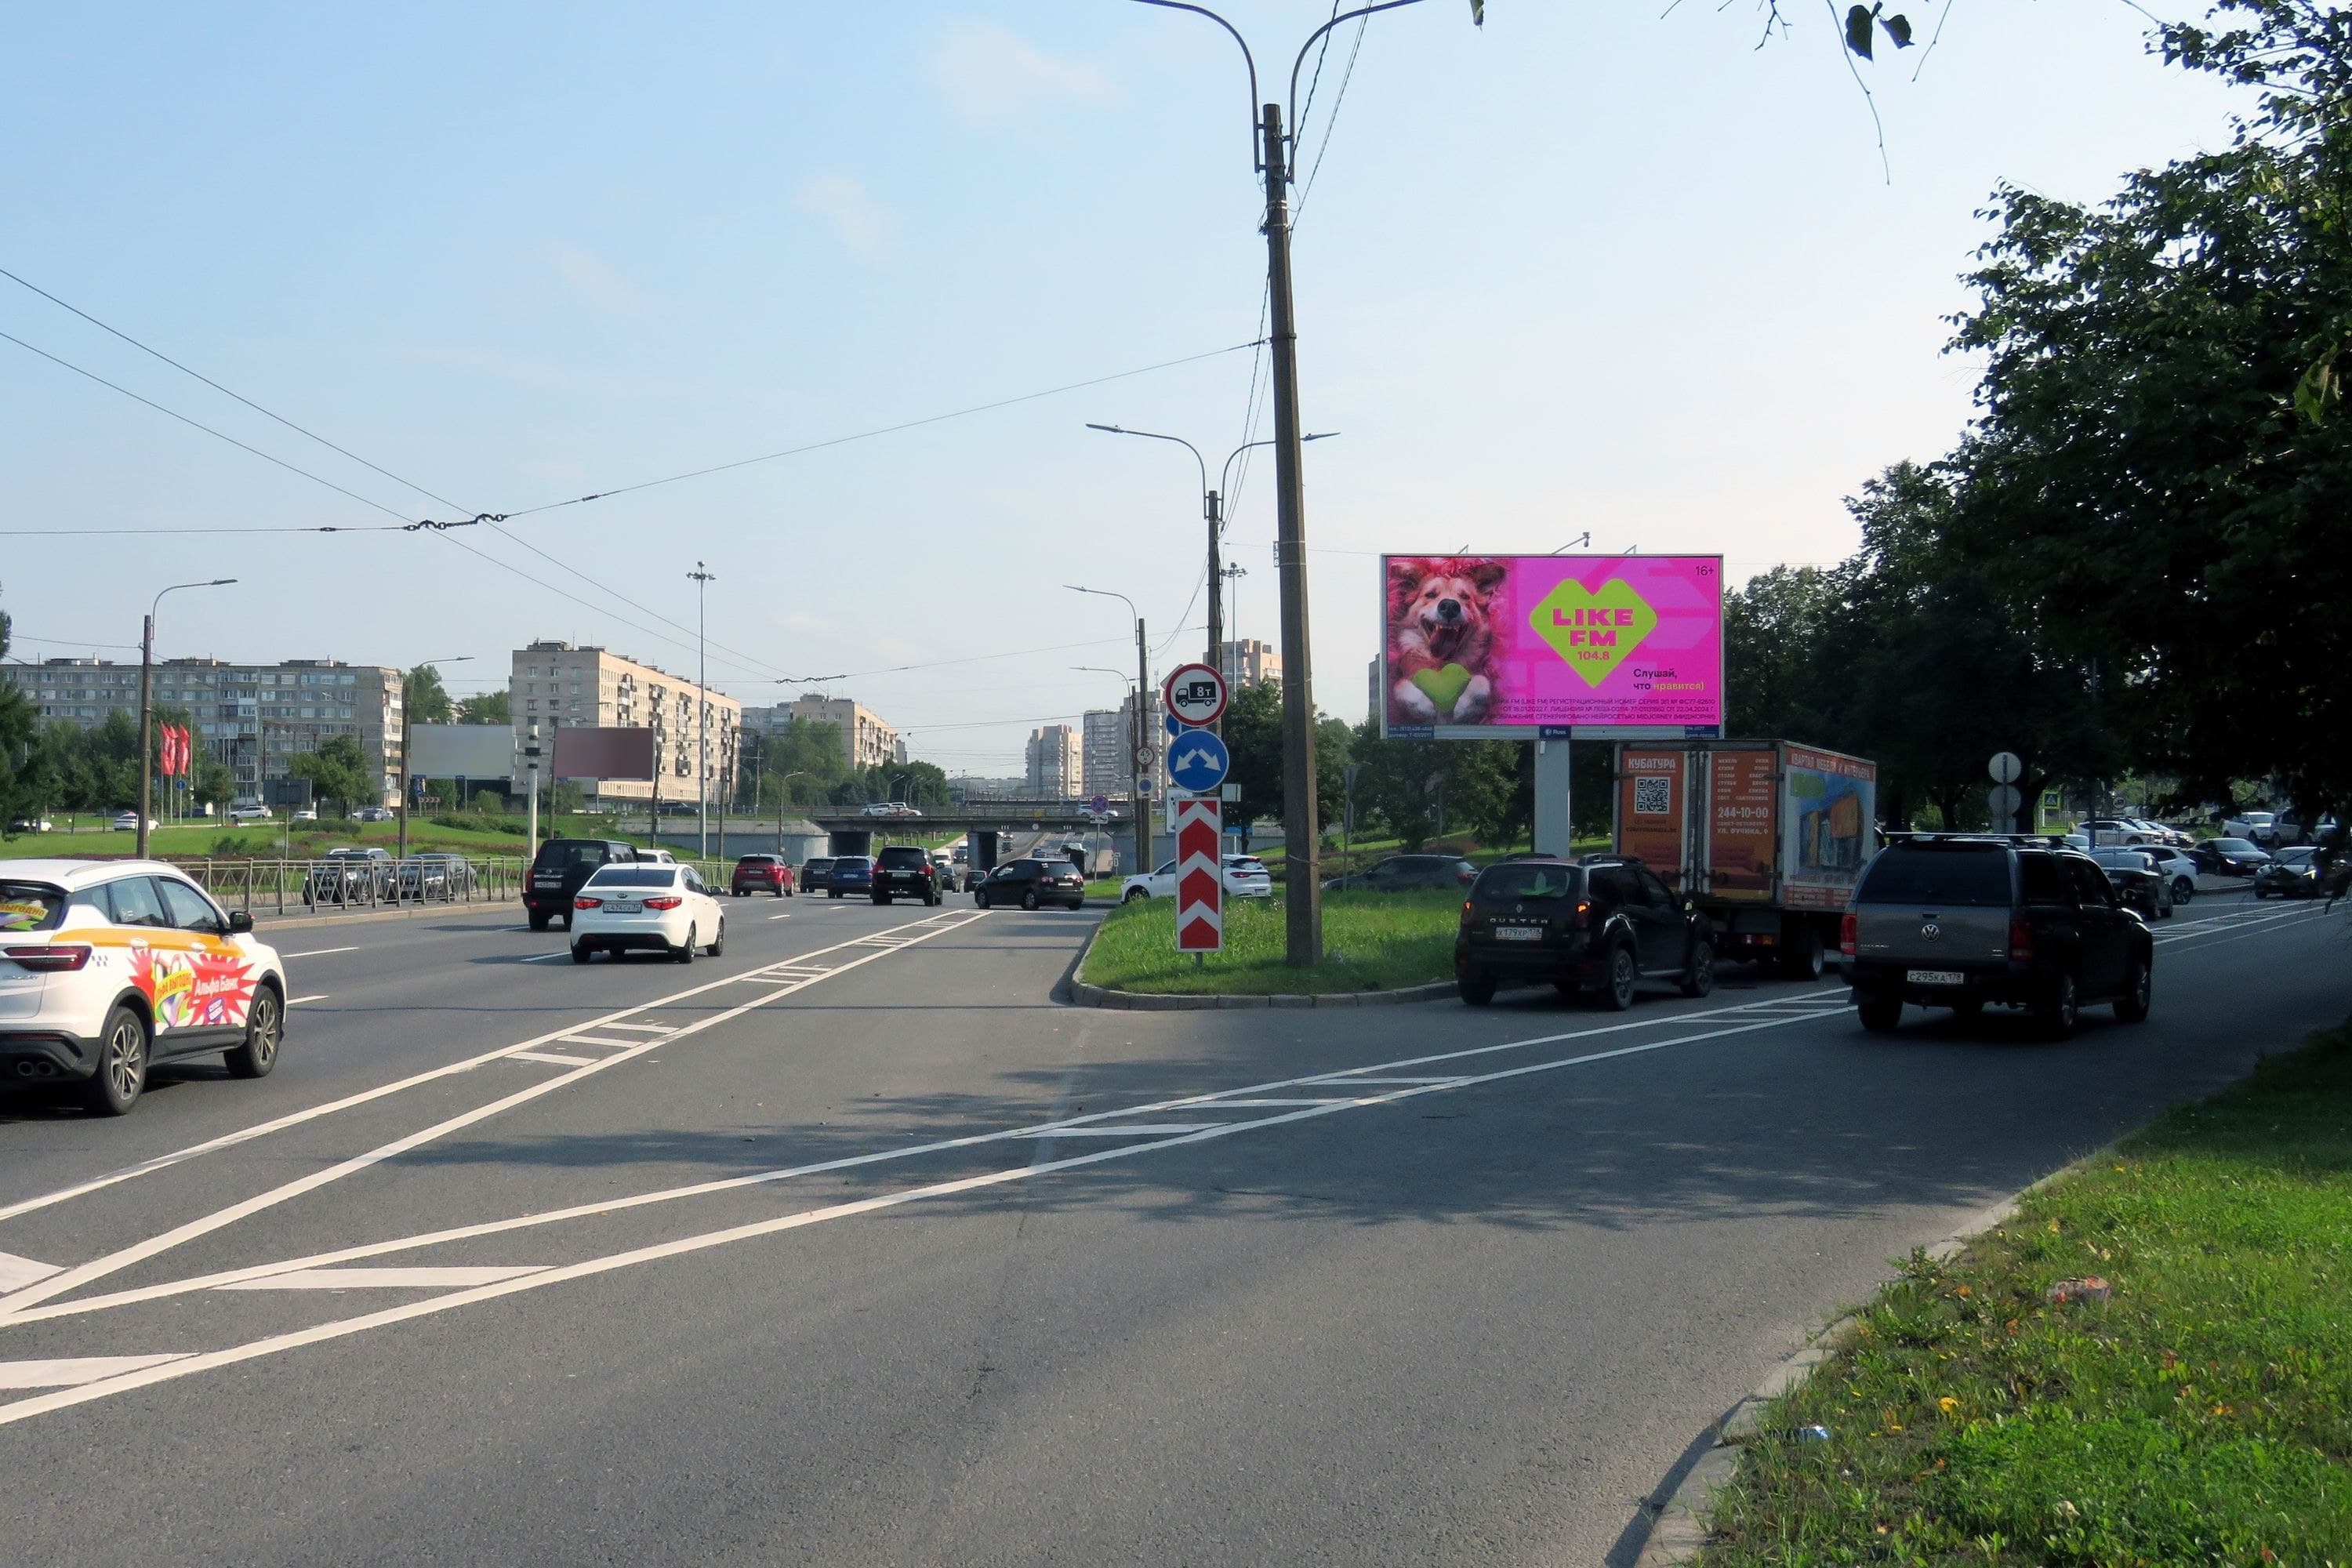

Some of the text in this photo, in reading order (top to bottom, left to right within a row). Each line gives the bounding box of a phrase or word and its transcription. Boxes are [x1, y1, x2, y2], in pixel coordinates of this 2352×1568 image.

[1696, 565, 1714, 576] 16+
[1552, 608, 1634, 626] LIKE
[1570, 630, 1617, 647] FM
[1578, 652, 1610, 660] 104.8
[1633, 668, 1678, 679] Слушай,
[1653, 681, 1704, 691] нравится)
[1628, 758, 1676, 769] КУБАТУРА
[1718, 807, 1769, 818] 244-10-00
[194, 977, 220, 998] Альфа
